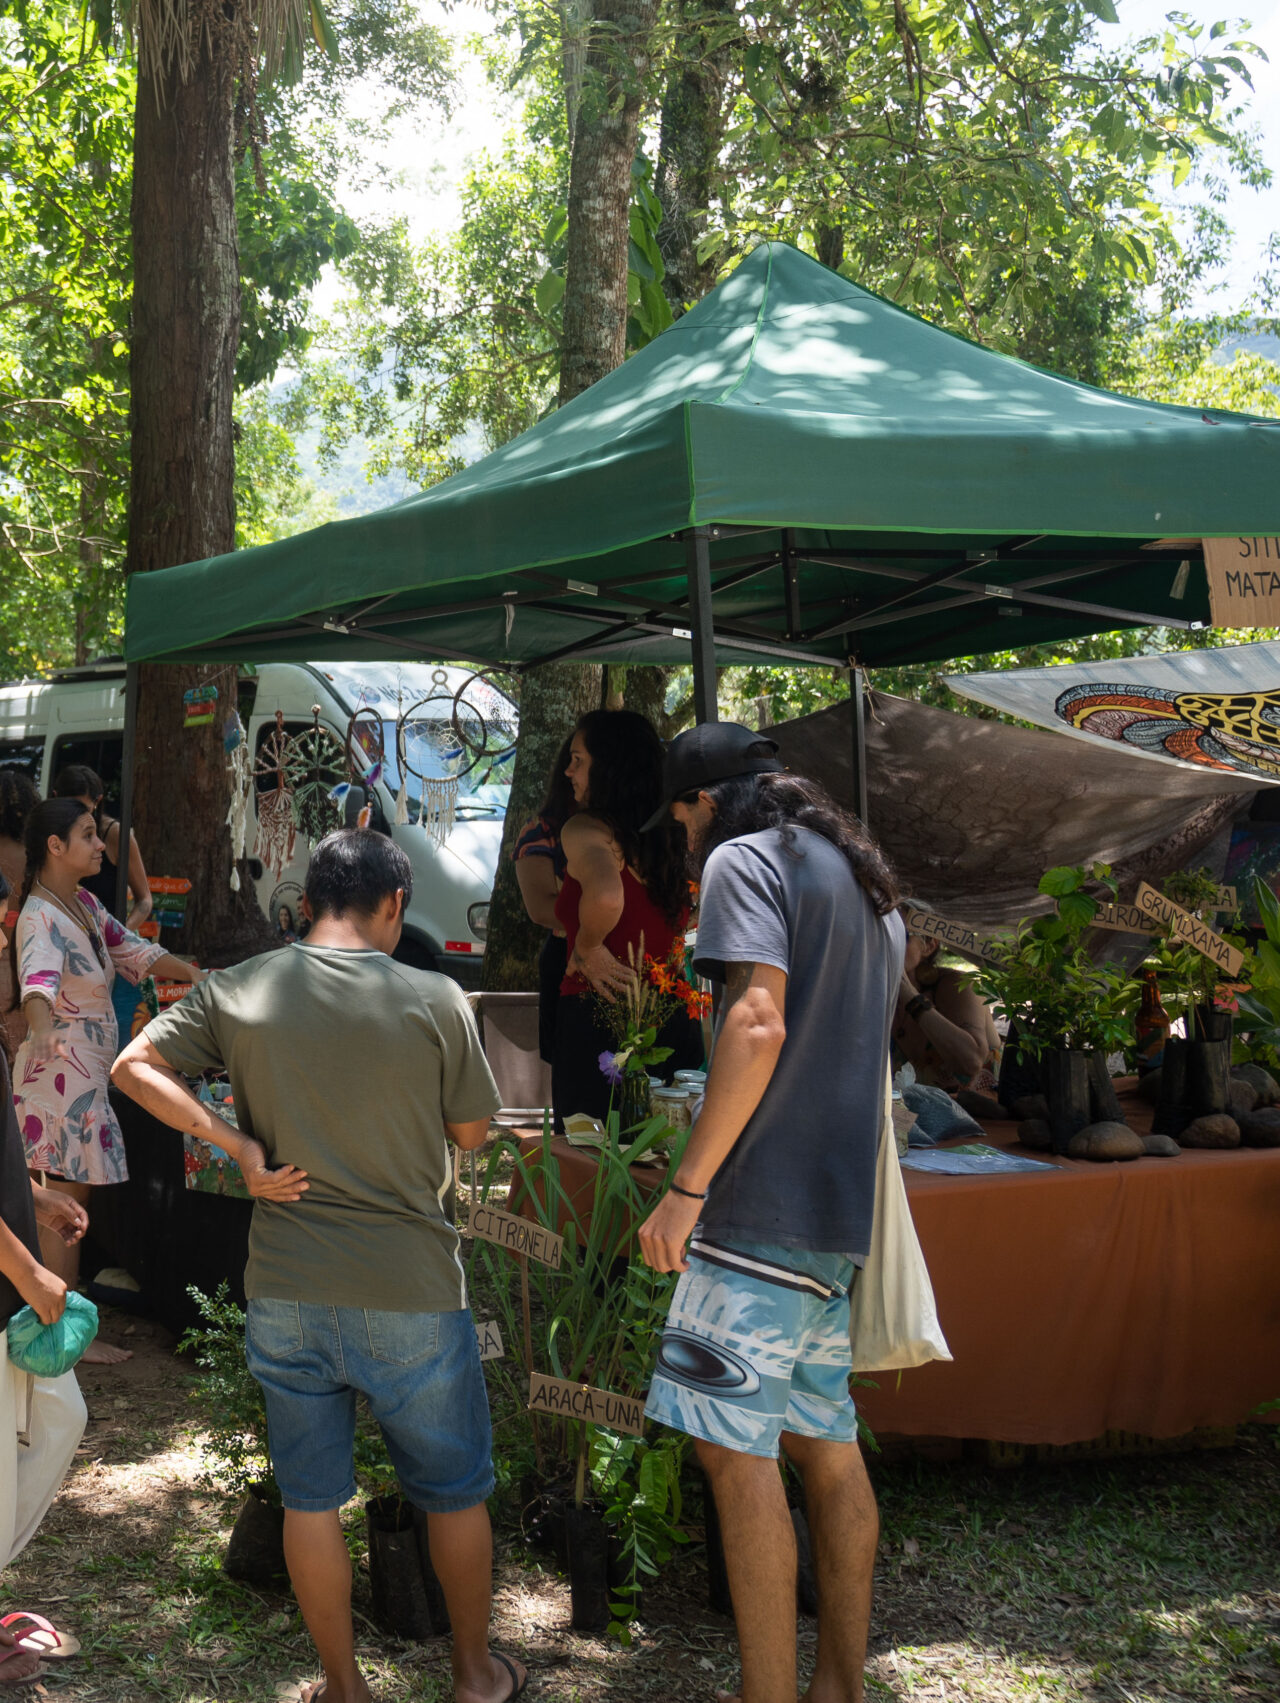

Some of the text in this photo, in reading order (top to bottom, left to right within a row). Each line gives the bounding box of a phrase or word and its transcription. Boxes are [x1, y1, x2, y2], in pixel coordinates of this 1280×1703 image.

[1225, 570, 1280, 598] MATA
[1141, 890, 1231, 968] GRUMIXAMA
[473, 1209, 560, 1267] CITRONELA
